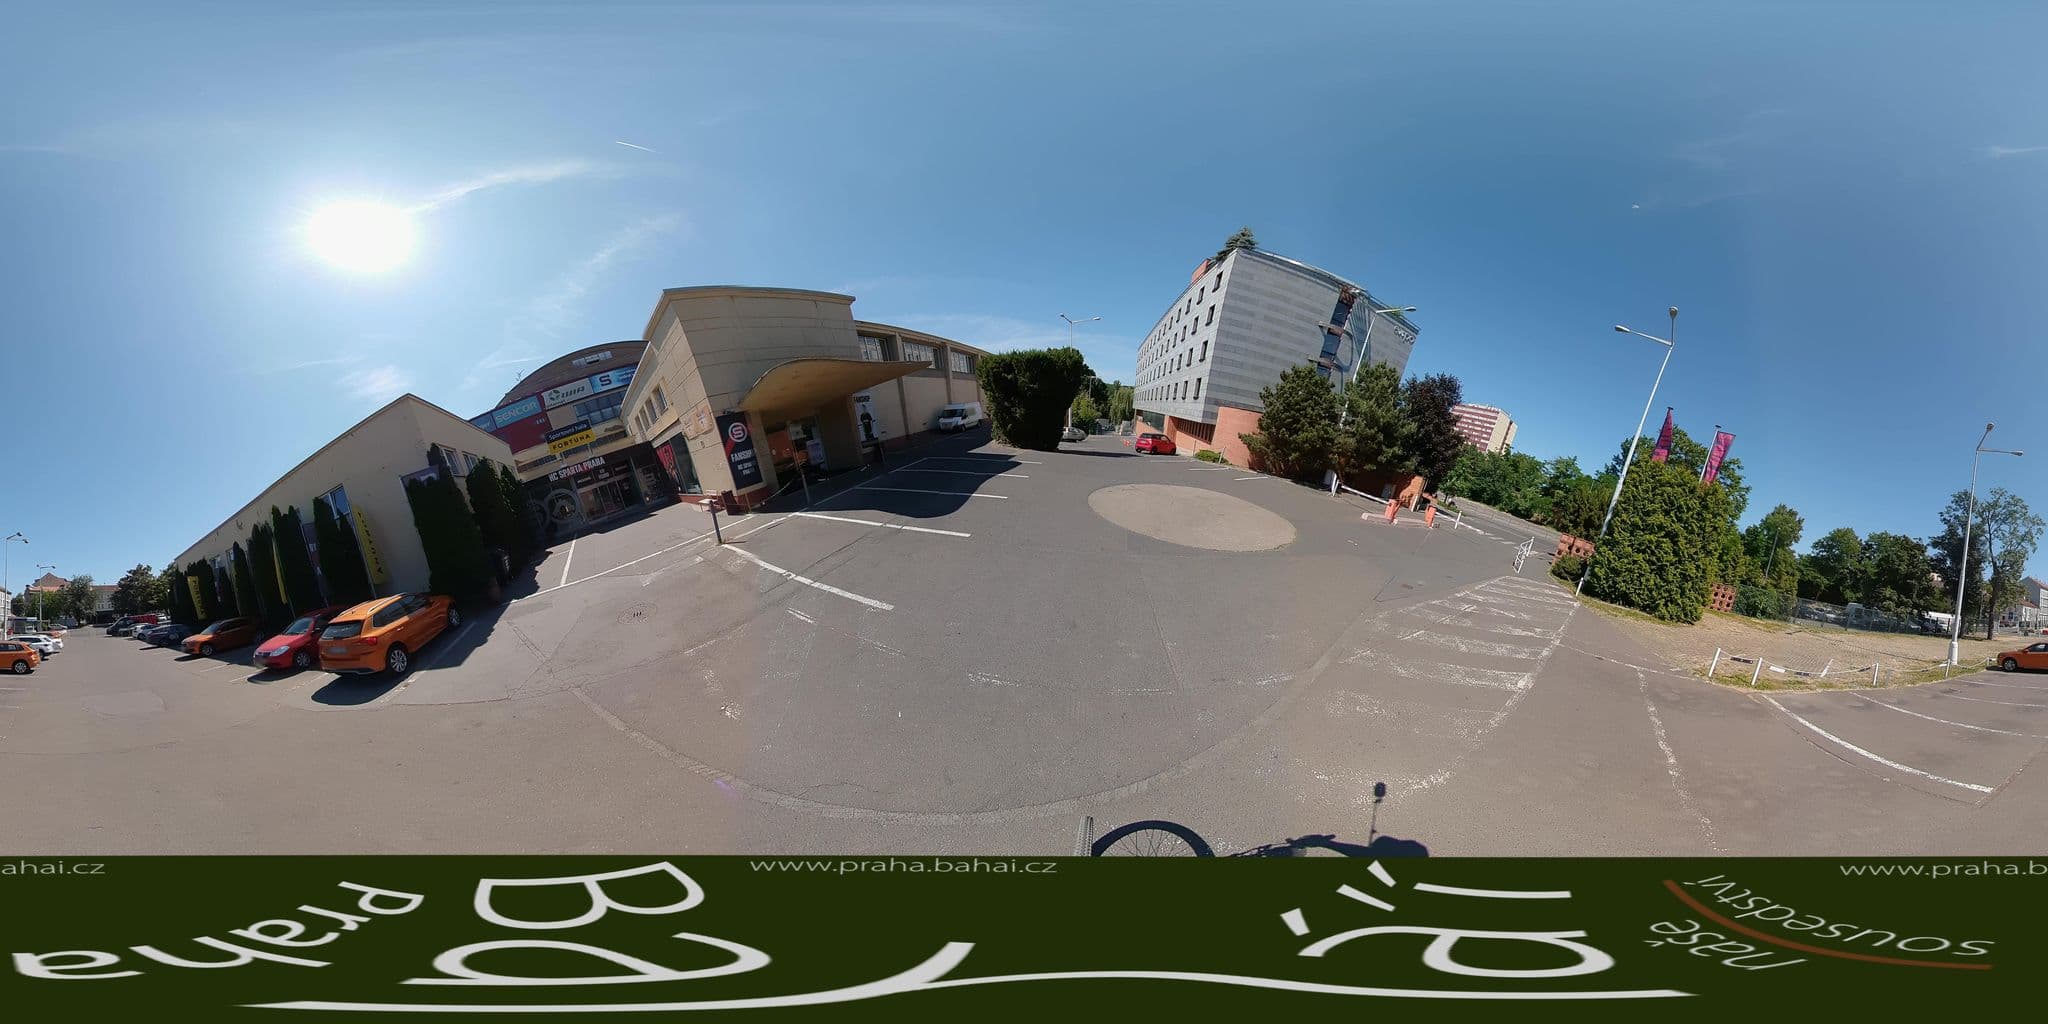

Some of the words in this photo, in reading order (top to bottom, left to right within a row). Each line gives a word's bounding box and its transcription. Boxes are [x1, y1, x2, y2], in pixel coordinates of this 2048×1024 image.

[495, 401, 537, 421] SENCOR
[552, 433, 590, 449] FORTUNA
[548, 472, 558, 481] HC
[559, 463, 583, 479] SPARTA
[582, 457, 606, 471] PRAHA
